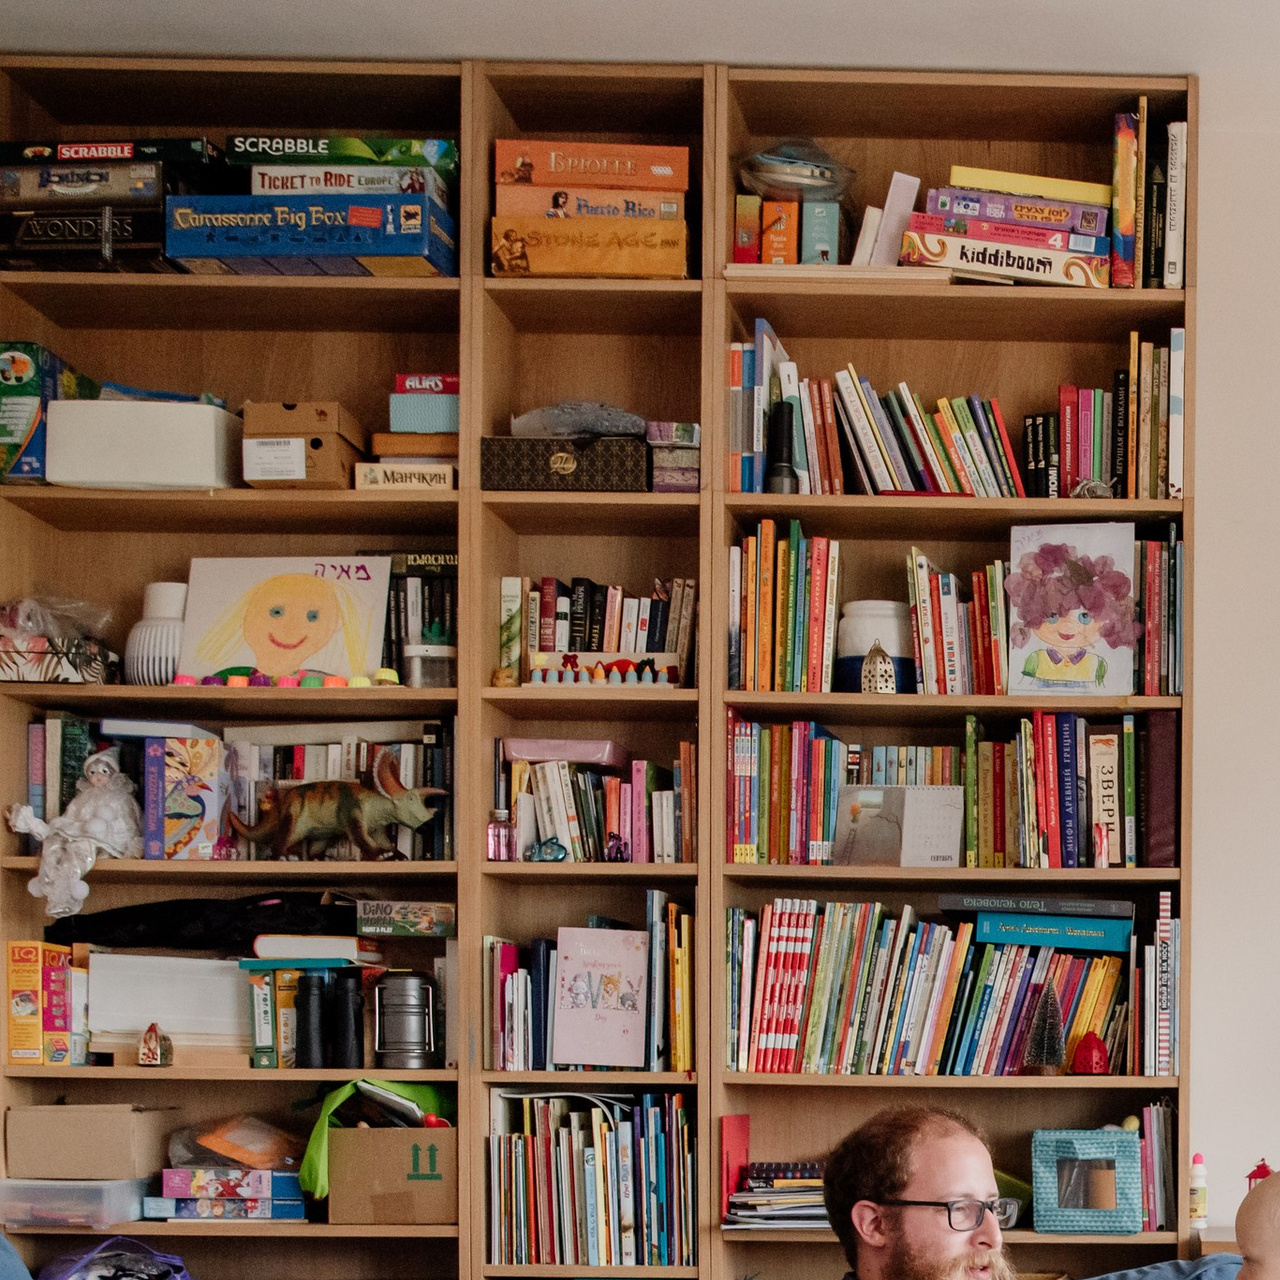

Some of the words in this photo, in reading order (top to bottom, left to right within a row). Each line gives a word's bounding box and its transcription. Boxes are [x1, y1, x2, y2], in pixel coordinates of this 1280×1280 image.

[60, 145, 132, 158] SCRABBLE
[234, 137, 329, 154] SCRABBLE
[1170, 133, 1178, 171] PICASSOS
[1170, 174, 1177, 183] IN
[576, 197, 620, 217] Puerto
[624, 199, 656, 218] Rico
[1169, 187, 1177, 232] BARCELONA
[274, 206, 306, 231] Big
[308, 206, 346, 226] Box
[526, 231, 599, 248] STONE
[605, 232, 657, 250] AGE
[1048, 233, 1064, 249] 4
[960, 245, 1053, 274] kiddiboom
[1117, 387, 1125, 427] ВОЛКАМИ
[1116, 437, 1125, 474] БЕГУЩАЯ
[383, 469, 447, 486] Манчкин
[946, 641, 956, 675] МАРШАК
[1062, 723, 1071, 763] ГРЕЦИИ
[1063, 769, 1073, 814] ДРЕВНЕЙ
[1065, 819, 1074, 852] МИФЫ
[963, 896, 1016, 908] человека
[1019, 900, 1047, 912] Тело
[13, 948, 38, 961] IQ
[44, 950, 59, 965] IQ
[1161, 962, 1167, 971] НА
